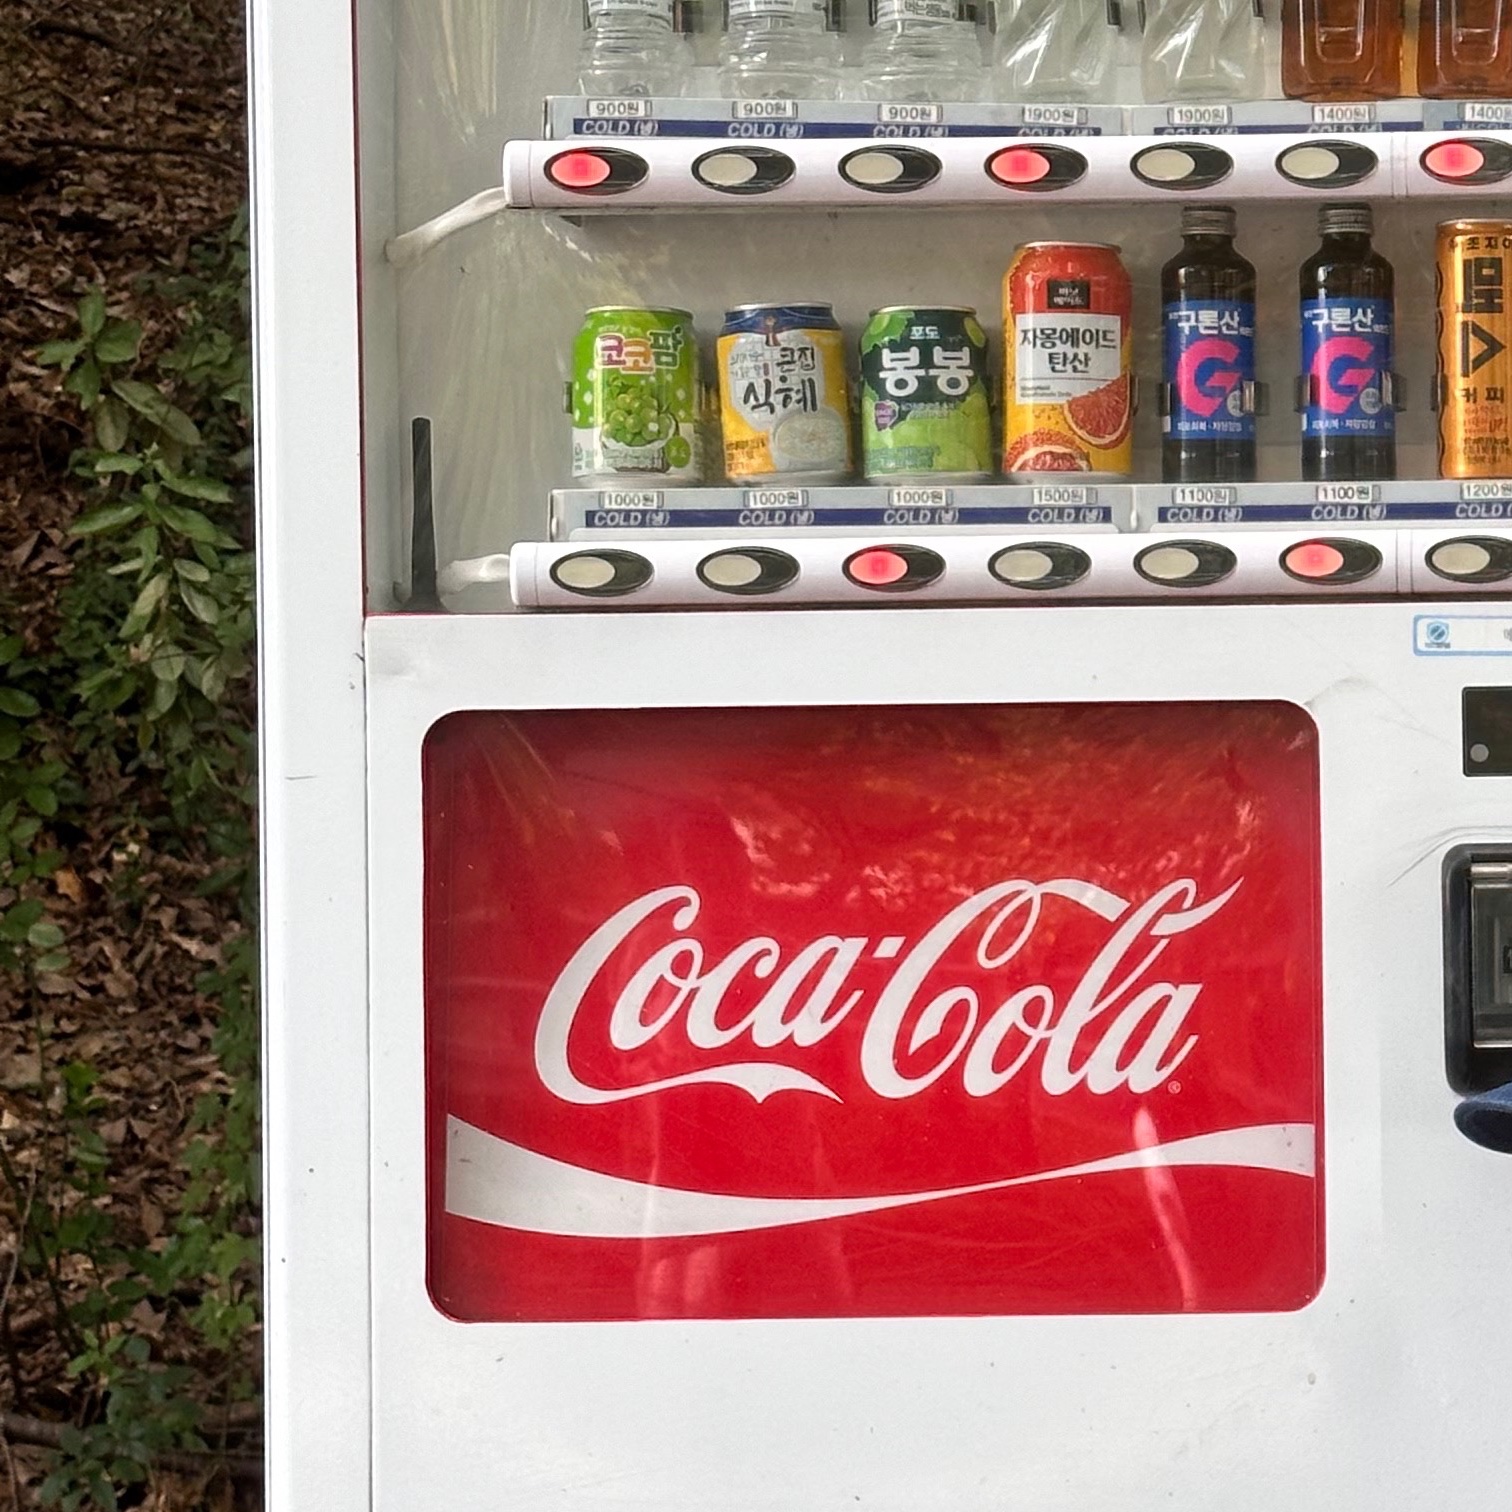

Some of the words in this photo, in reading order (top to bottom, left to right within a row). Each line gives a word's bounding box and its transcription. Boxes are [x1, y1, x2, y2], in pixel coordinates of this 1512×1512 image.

[582, 120, 630, 135] COLD
[728, 123, 775, 138] COLD
[1178, 310, 1240, 334] 구론산
[1311, 307, 1374, 333] 구론산
[910, 325, 940, 341] 포도
[1020, 327, 1117, 349] 자몽에이드
[595, 325, 684, 375] 코코팜
[1048, 352, 1091, 374] 탄산
[878, 346, 974, 397] 봉봉
[743, 375, 819, 415] 식혜
[1461, 387, 1505, 403] 커피
[594, 511, 641, 526] COLD
[738, 511, 786, 526] COLD
[884, 510, 931, 524] COLD
[1028, 508, 1075, 523] COLD
[1167, 508, 1214, 523] COLD
[1311, 506, 1359, 521] COLD
[1455, 503, 1503, 518] COLD
[534, 876, 1244, 1103] Coca-Cola
